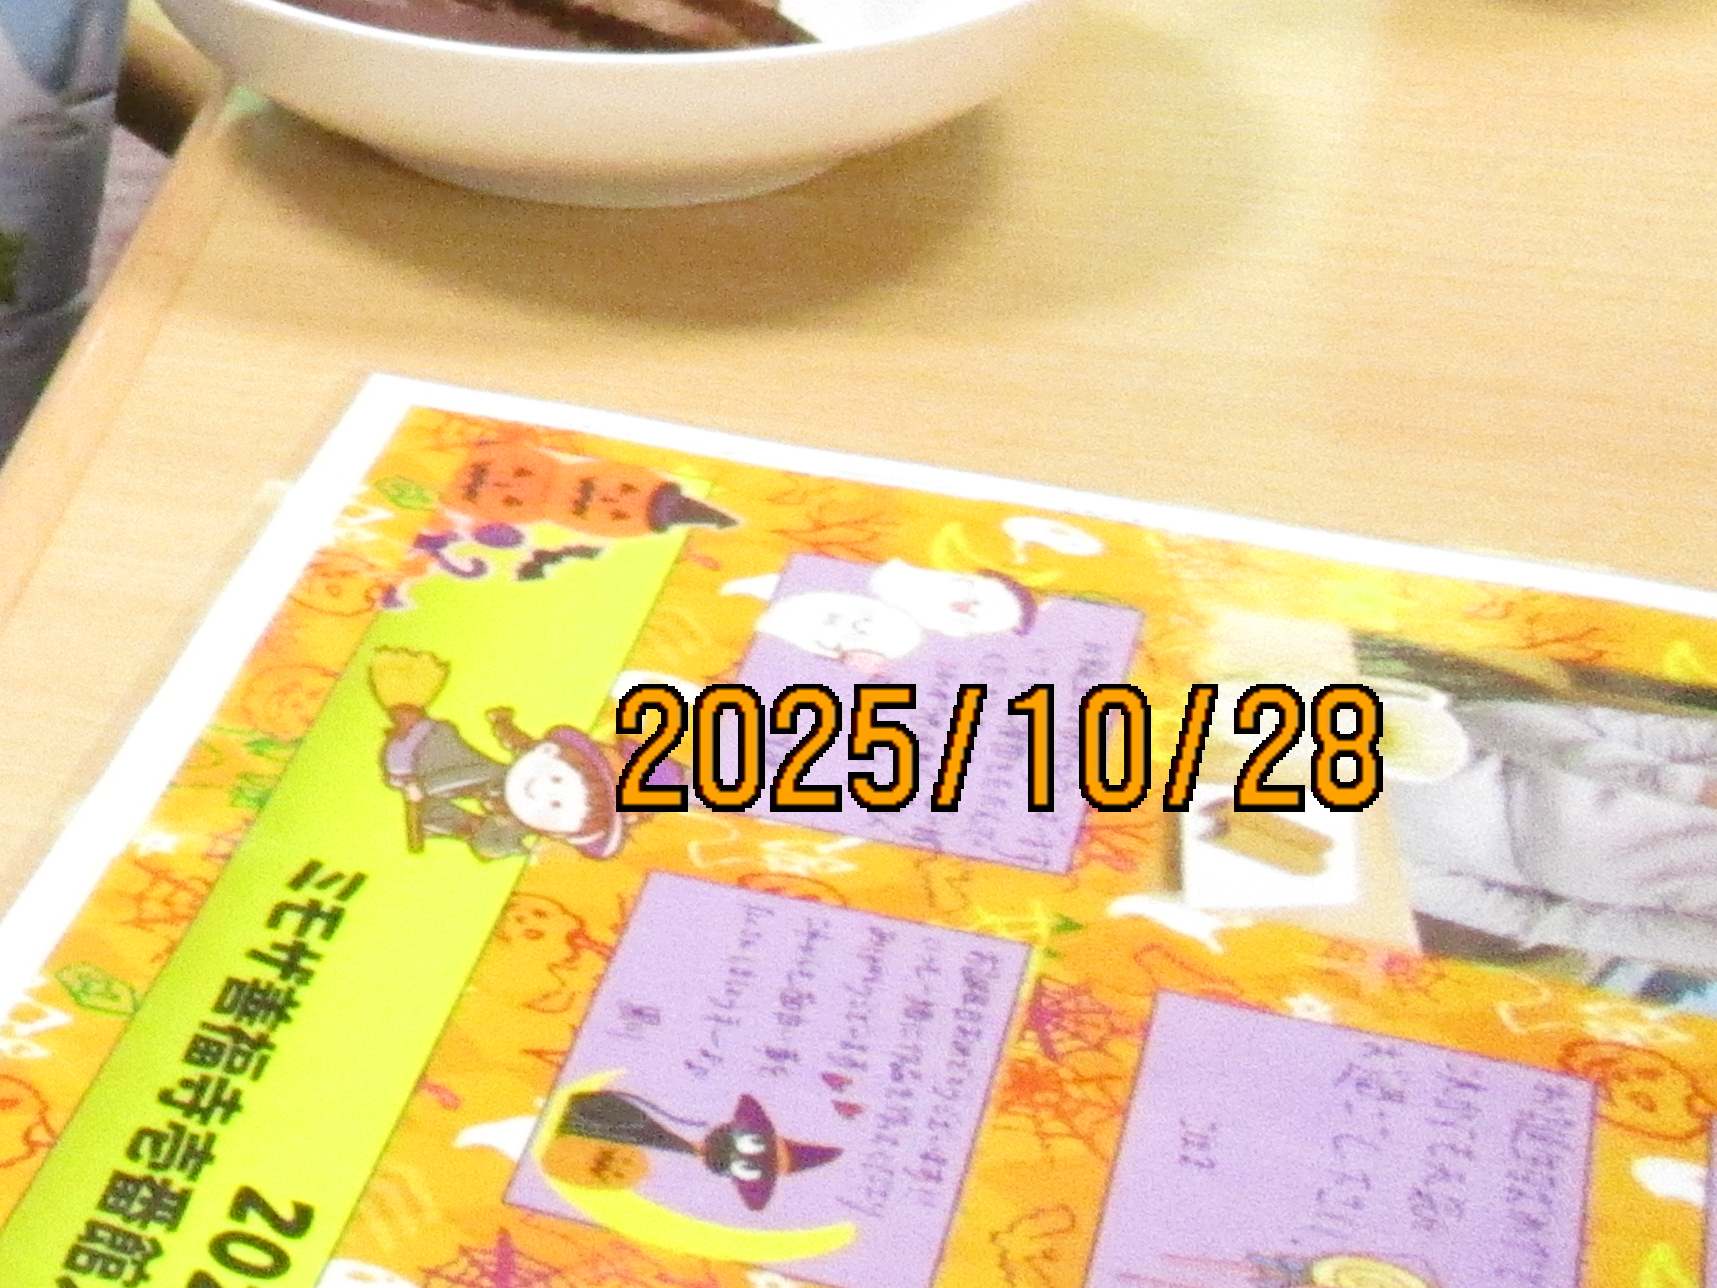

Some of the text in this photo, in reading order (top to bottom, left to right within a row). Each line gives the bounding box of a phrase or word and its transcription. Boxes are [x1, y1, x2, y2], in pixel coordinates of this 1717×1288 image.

[56, 858, 368, 1288] ミモザ善福寺壱番館
